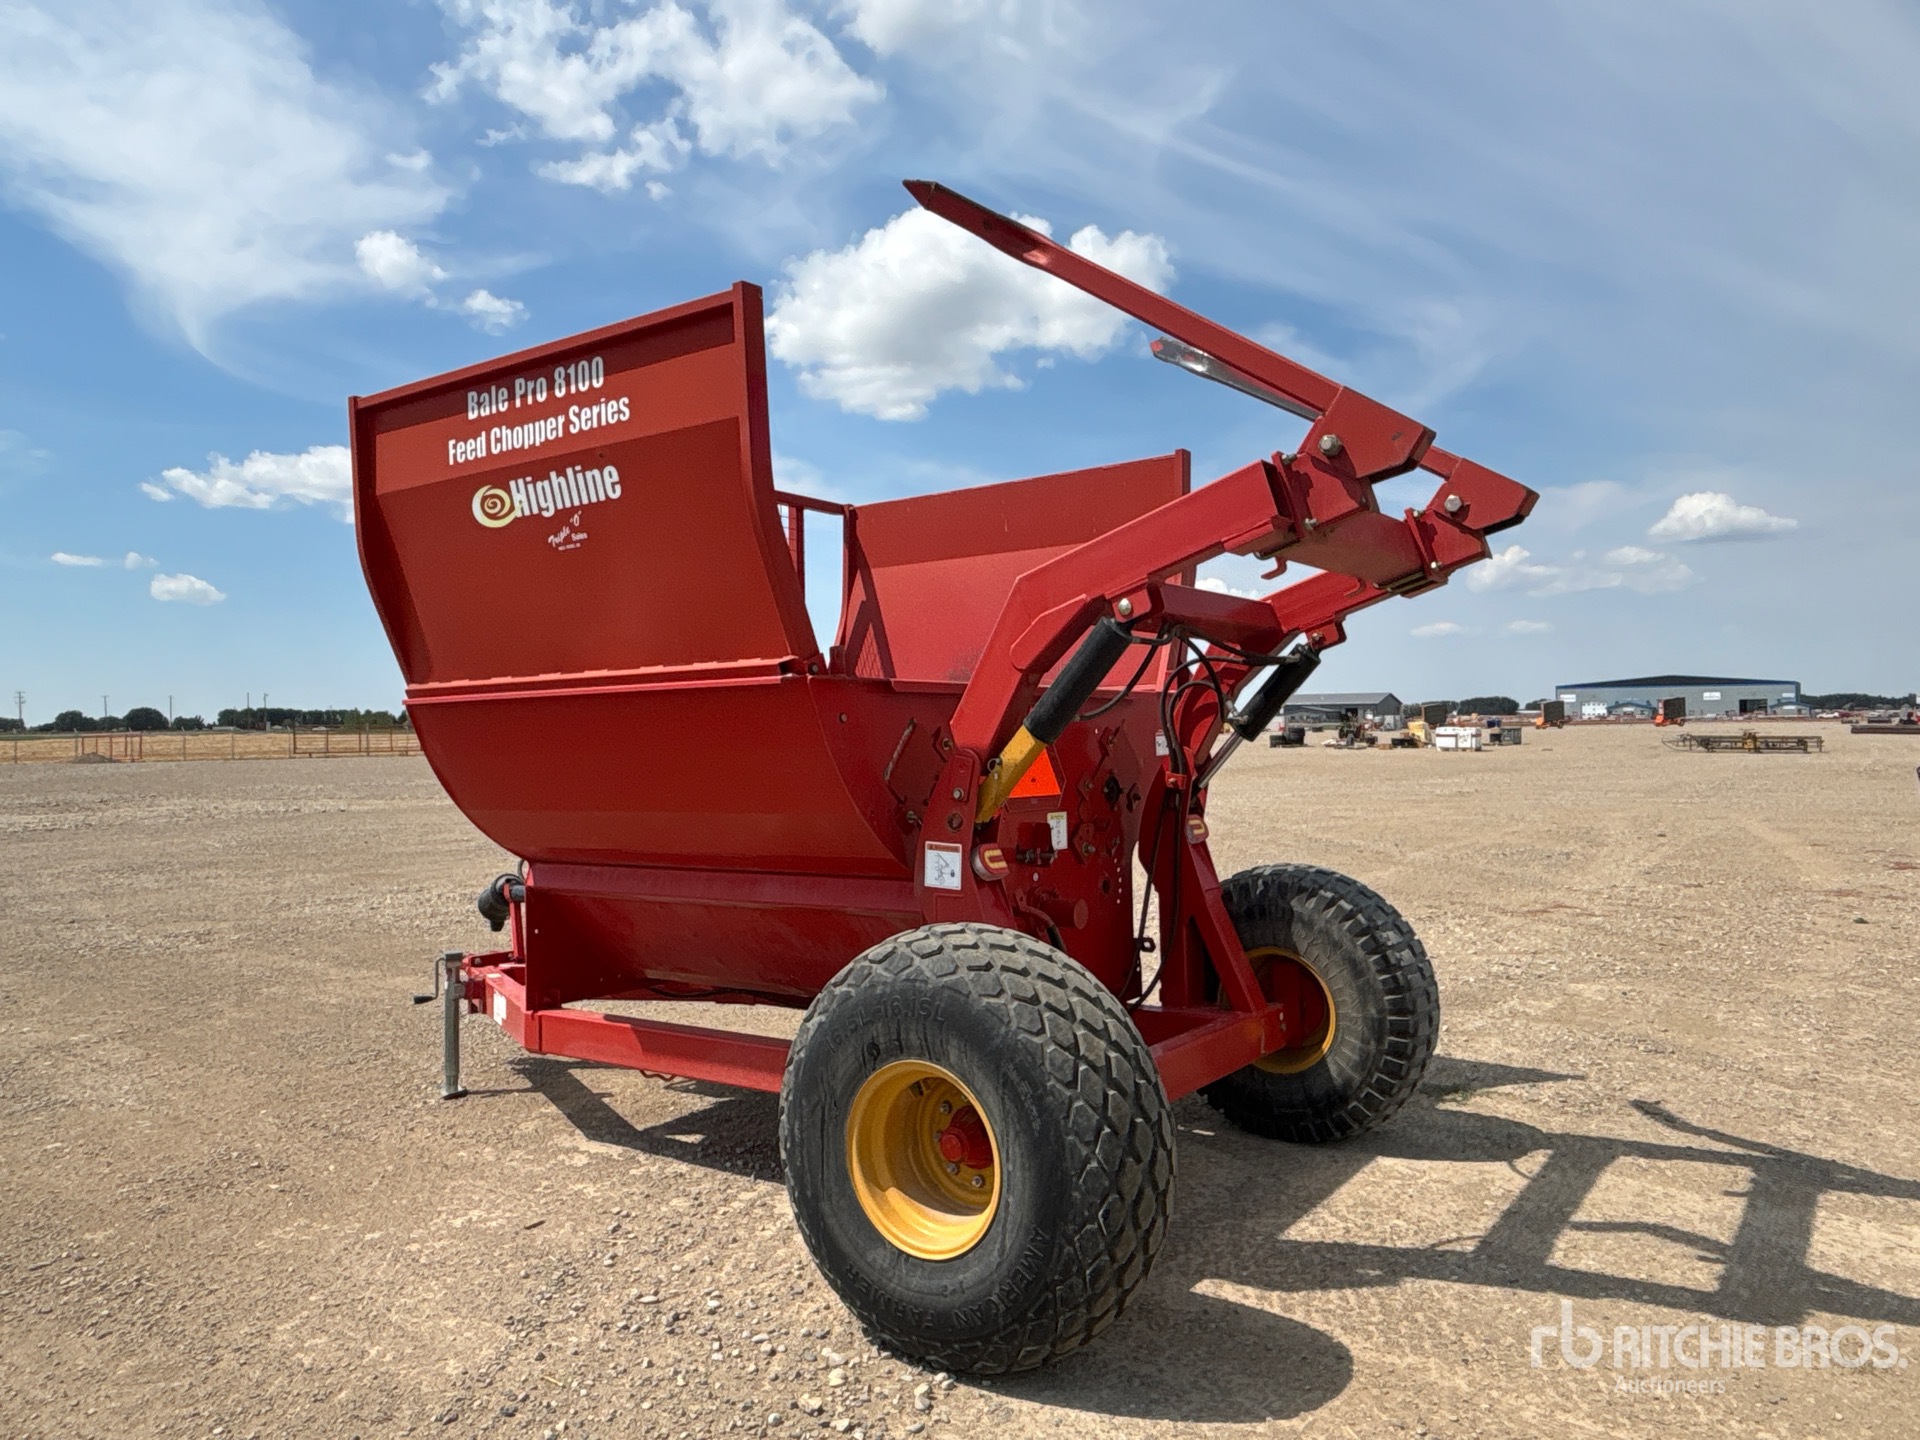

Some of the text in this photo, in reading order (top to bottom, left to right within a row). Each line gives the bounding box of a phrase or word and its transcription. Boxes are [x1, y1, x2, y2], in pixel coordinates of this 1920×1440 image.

[467, 356, 605, 420] Bale Pro 8100
[447, 396, 630, 465] Feed Chopper Series
[509, 465, 622, 518] Highline
